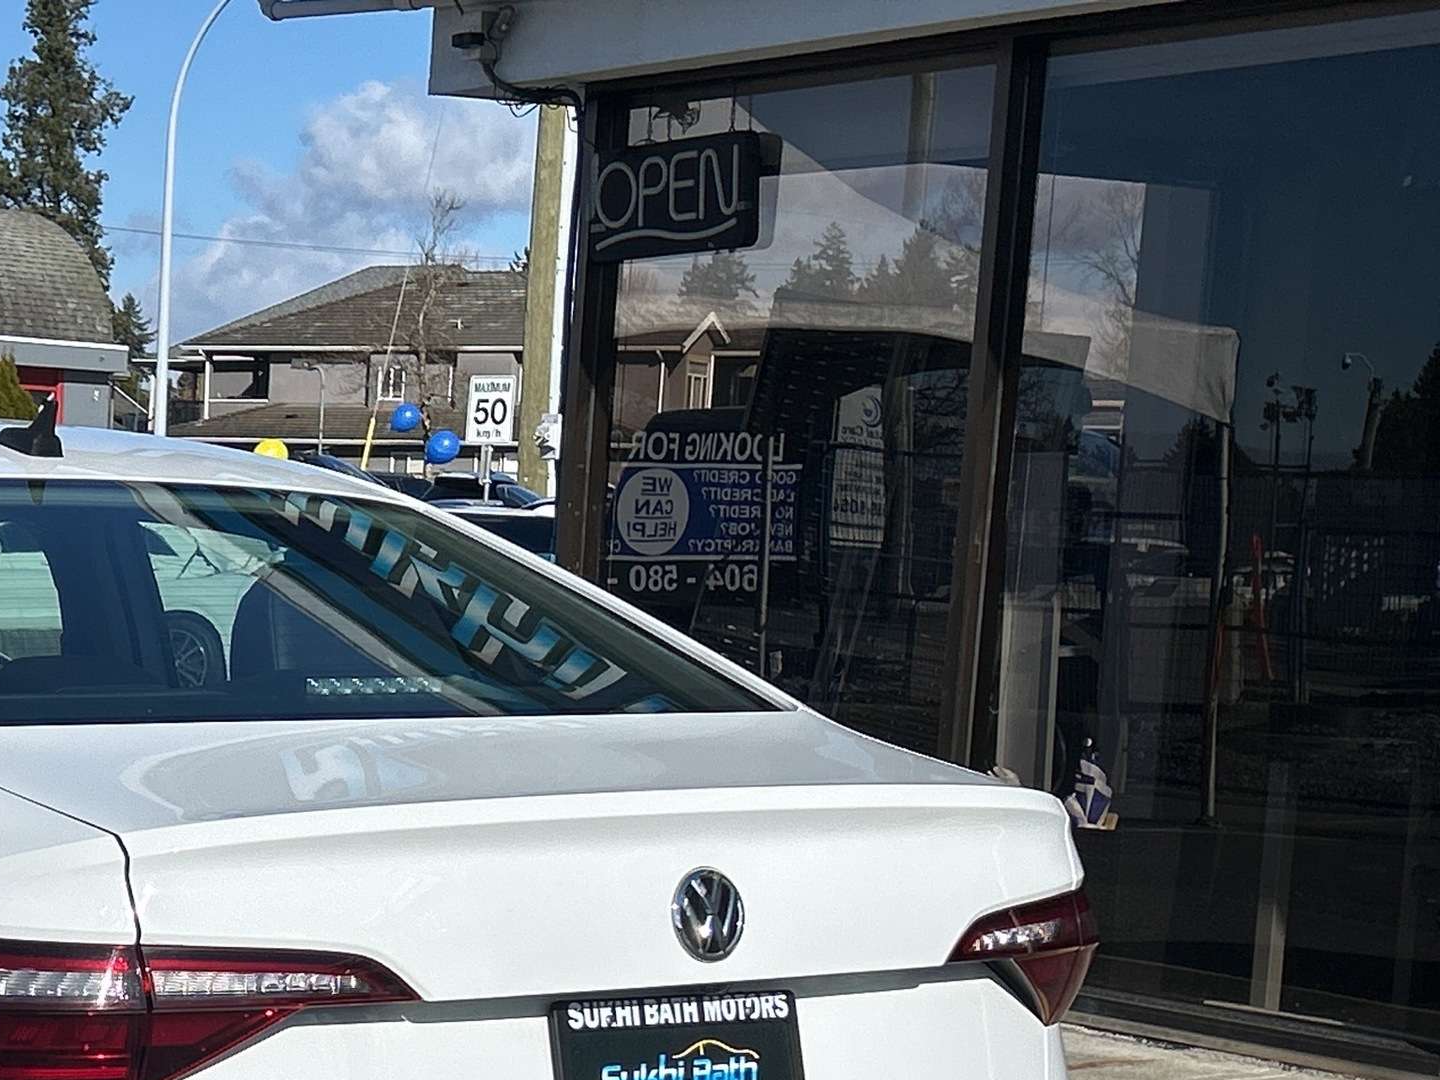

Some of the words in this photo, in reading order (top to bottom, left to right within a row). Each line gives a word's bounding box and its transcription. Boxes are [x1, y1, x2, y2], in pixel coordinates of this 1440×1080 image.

[595, 144, 739, 229] OPEN
[474, 382, 511, 392] MAXIMUM
[474, 398, 507, 425] 50
[477, 428, 501, 439] km/h
[567, 1001, 641, 1030] SUKHI
[644, 996, 699, 1025] BATH
[703, 993, 789, 1022] MOTORS
